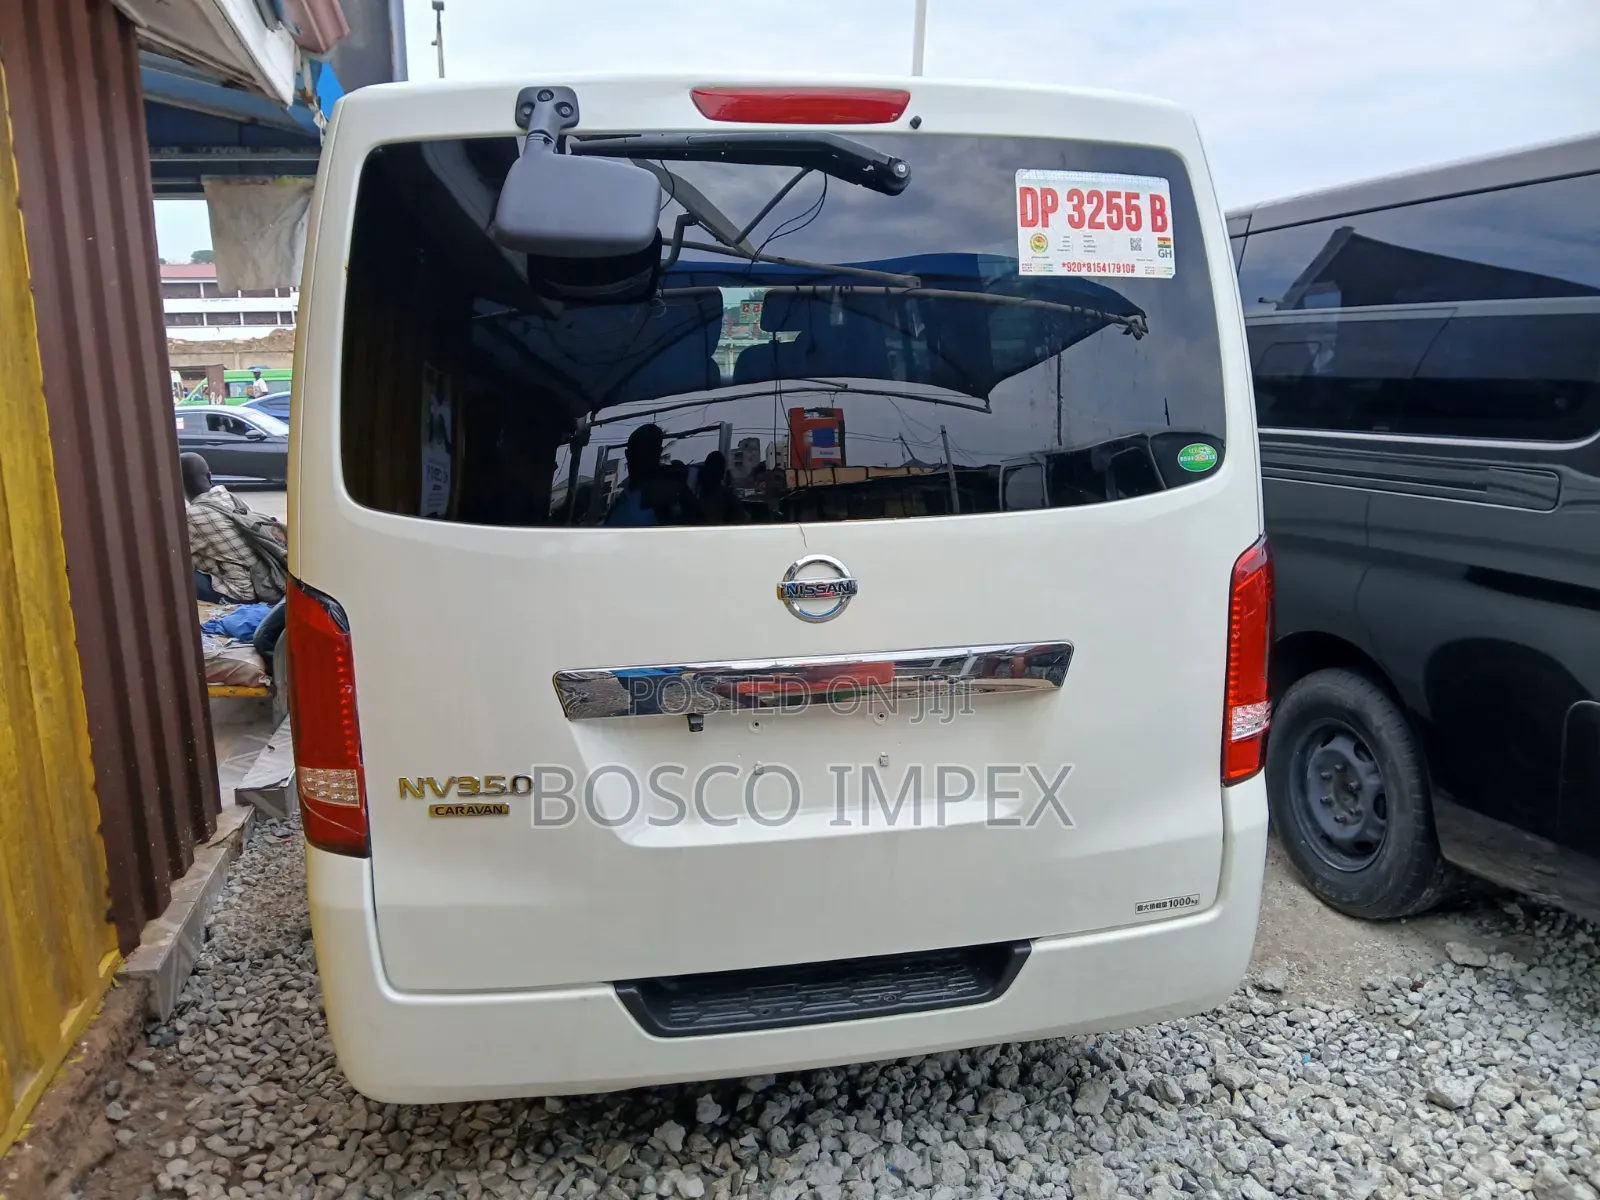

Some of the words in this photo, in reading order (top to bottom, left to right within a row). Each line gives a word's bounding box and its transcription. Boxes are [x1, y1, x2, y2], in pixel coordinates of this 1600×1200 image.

[1019, 186, 1059, 228] DP
[1066, 188, 1142, 232] 3255
[1149, 194, 1168, 233] B
[1157, 248, 1173, 259] GH
[786, 582, 850, 596] NISSAN
[398, 774, 534, 800] NV350
[435, 805, 504, 816] CARAVAN
